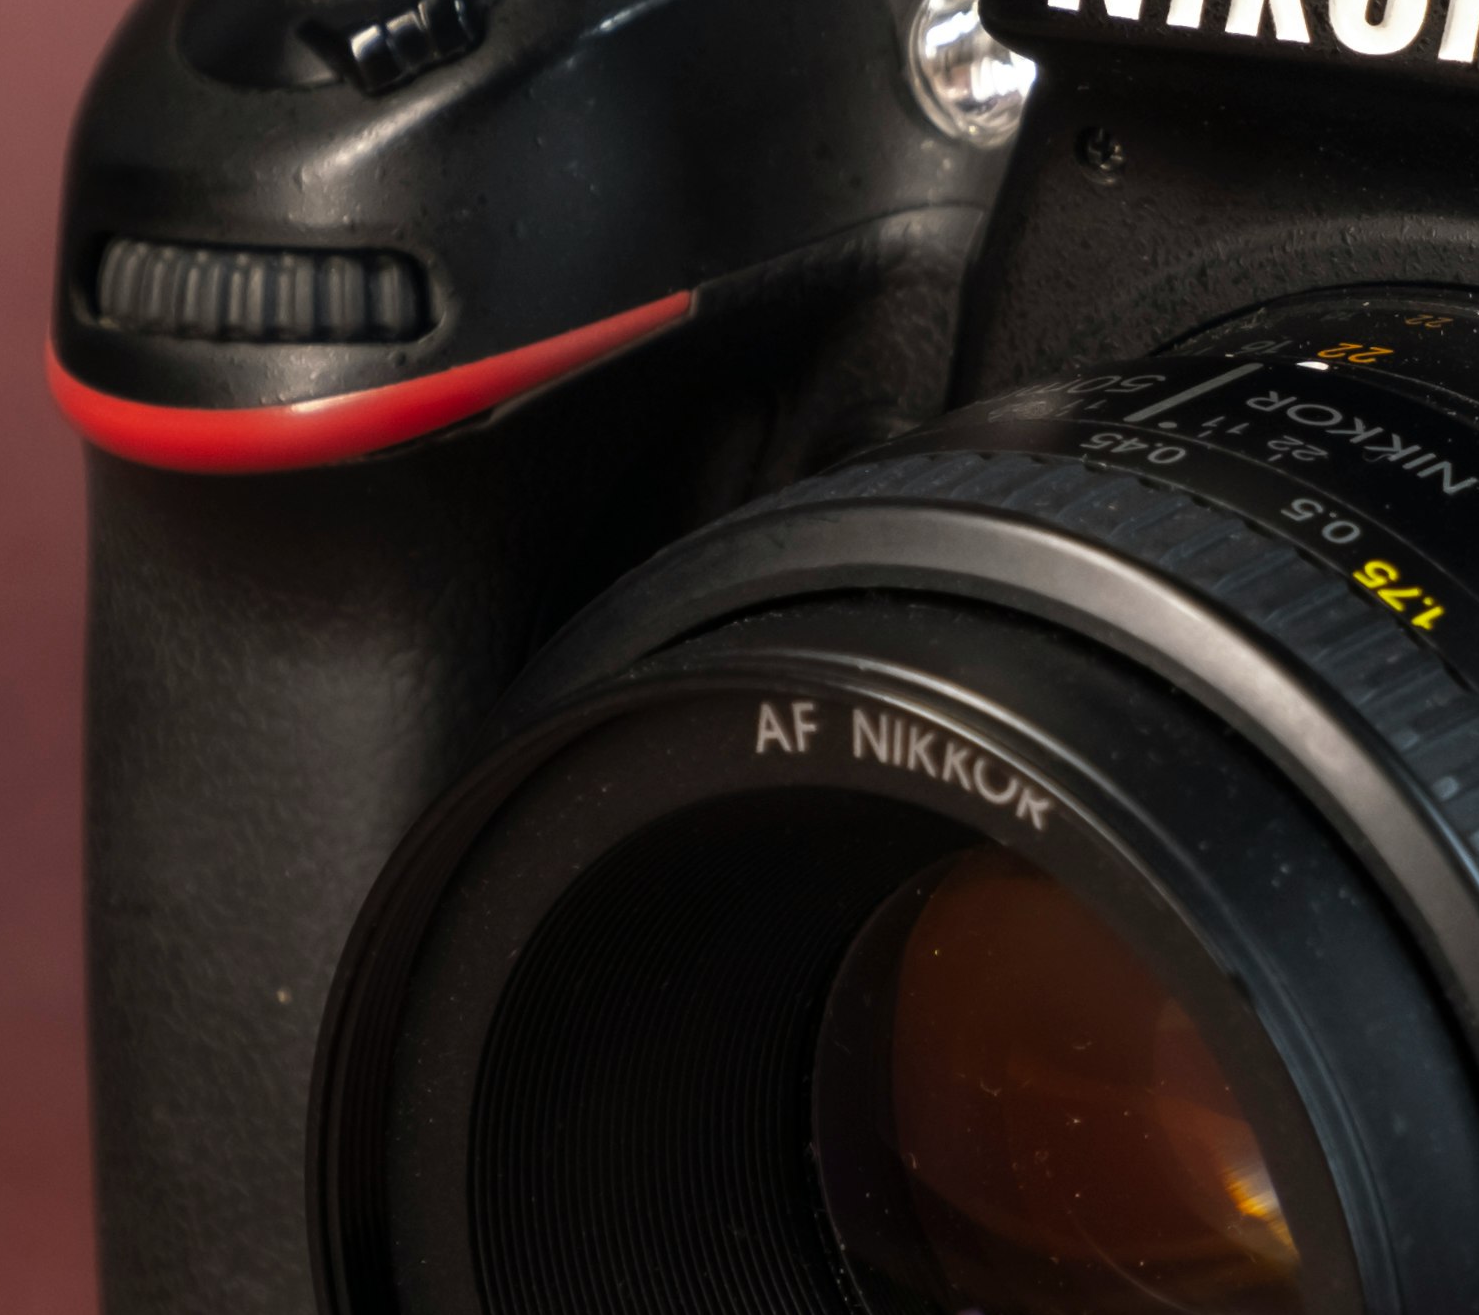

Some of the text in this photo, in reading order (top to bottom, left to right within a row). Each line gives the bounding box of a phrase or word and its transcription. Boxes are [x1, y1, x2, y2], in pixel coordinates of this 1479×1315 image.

[1317, 342, 1395, 364] 22
[1080, 432, 1187, 465] 0.45
[1244, 389, 1478, 497] NIKKOR
[1281, 498, 1362, 545] 0.5
[1353, 558, 1449, 632] 1.75
[755, 702, 1057, 831] AF NIKKOR
